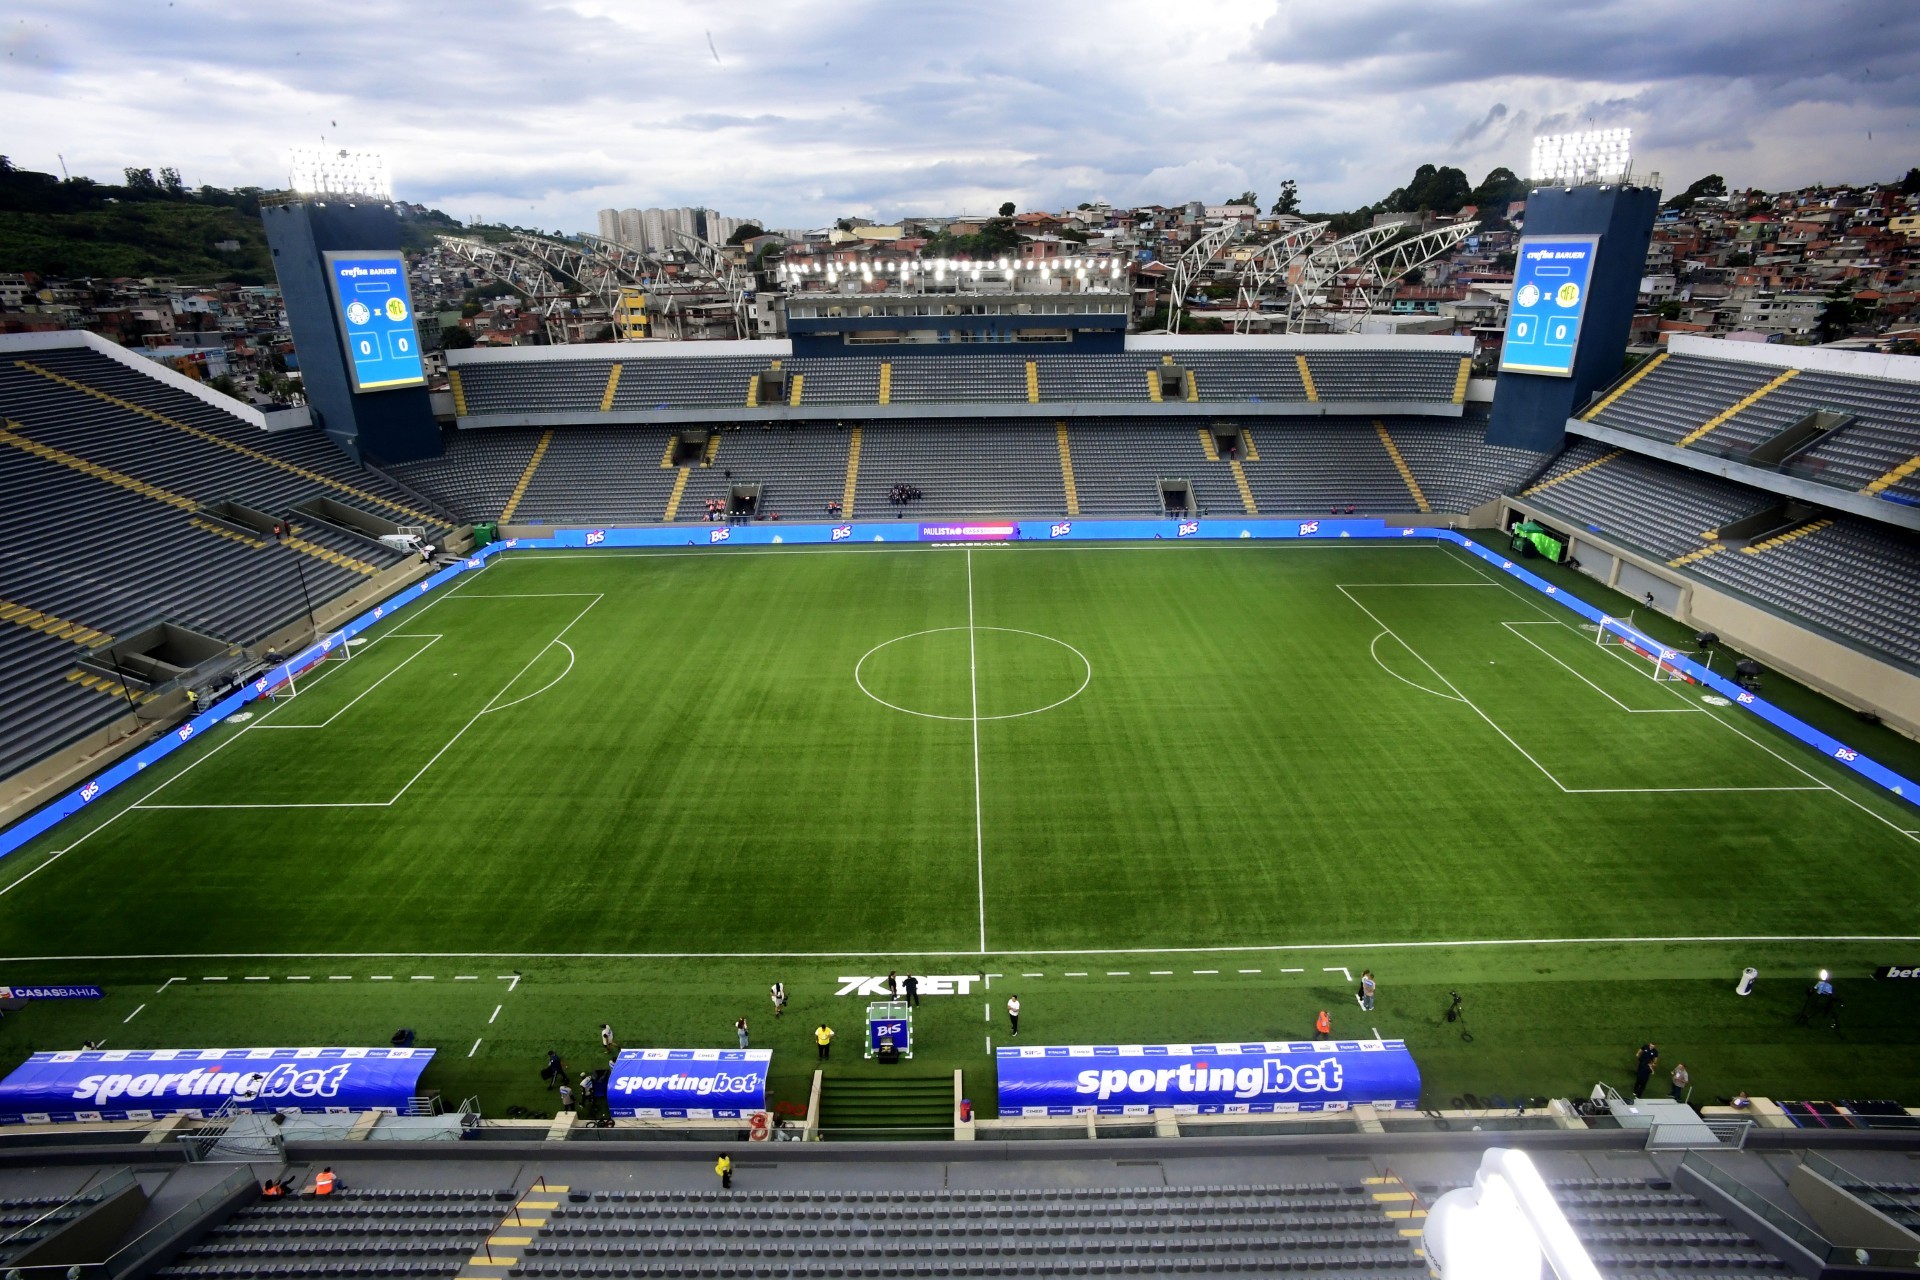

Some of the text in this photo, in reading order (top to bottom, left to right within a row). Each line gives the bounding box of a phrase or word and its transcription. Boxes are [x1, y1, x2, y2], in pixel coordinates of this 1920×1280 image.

[1555, 251, 1585, 259] BARUERI
[341, 267, 368, 278] crefisa
[1517, 323, 1566, 339] 0 0
[361, 338, 408, 355] 0 0
[15, 988, 99, 997] CASASBAHIA
[72, 1063, 352, 1105] sportingbet
[615, 1073, 757, 1095] sportingbet
[1076, 1057, 1343, 1100] sportingbet
